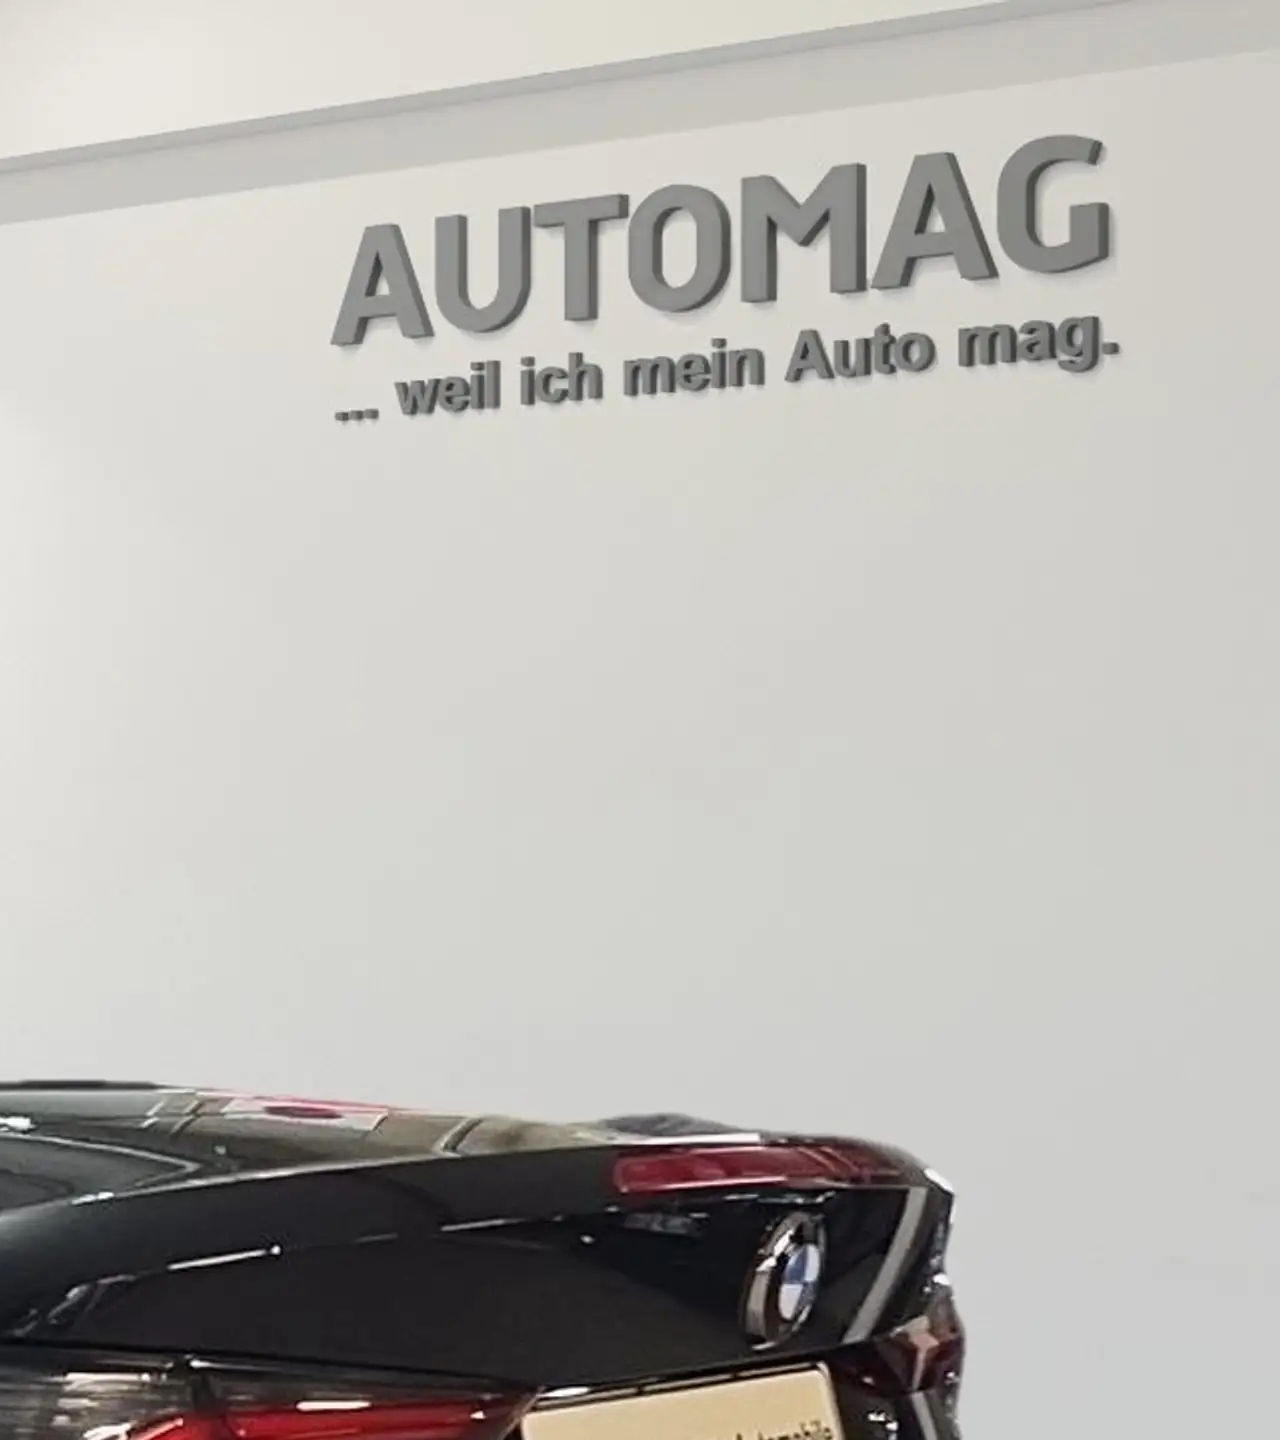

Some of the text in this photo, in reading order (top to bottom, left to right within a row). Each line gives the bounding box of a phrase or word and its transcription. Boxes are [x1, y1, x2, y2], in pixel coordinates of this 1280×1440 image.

[330, 134, 1110, 346] AUTOMAG
[395, 360, 501, 415] weil
[520, 352, 603, 405] ich
[623, 338, 765, 396] mein
[785, 323, 936, 382] Auto
[958, 316, 1120, 373] mag.
